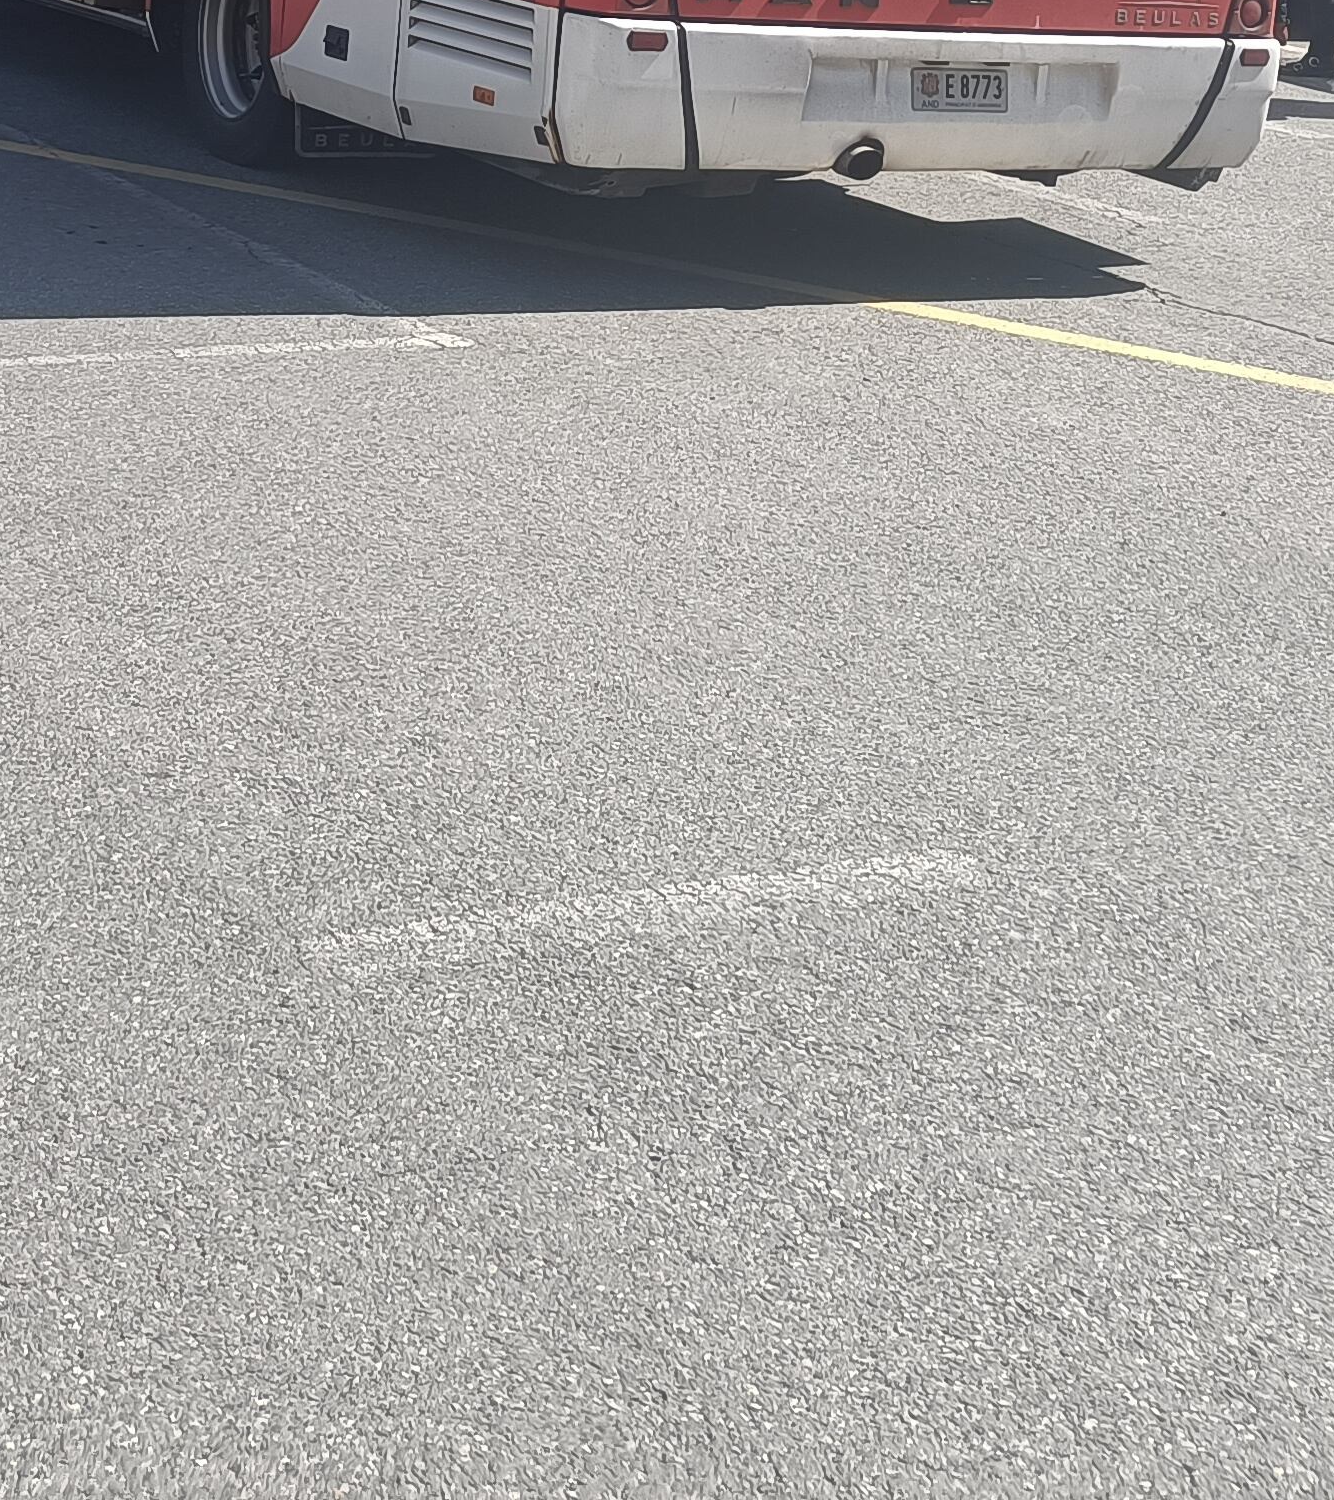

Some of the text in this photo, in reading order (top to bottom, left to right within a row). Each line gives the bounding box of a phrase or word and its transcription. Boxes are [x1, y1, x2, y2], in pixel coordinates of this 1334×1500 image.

[1116, 8, 1219, 27] BEULAS
[945, 73, 1002, 100] E 8773
[921, 100, 940, 109] AND
